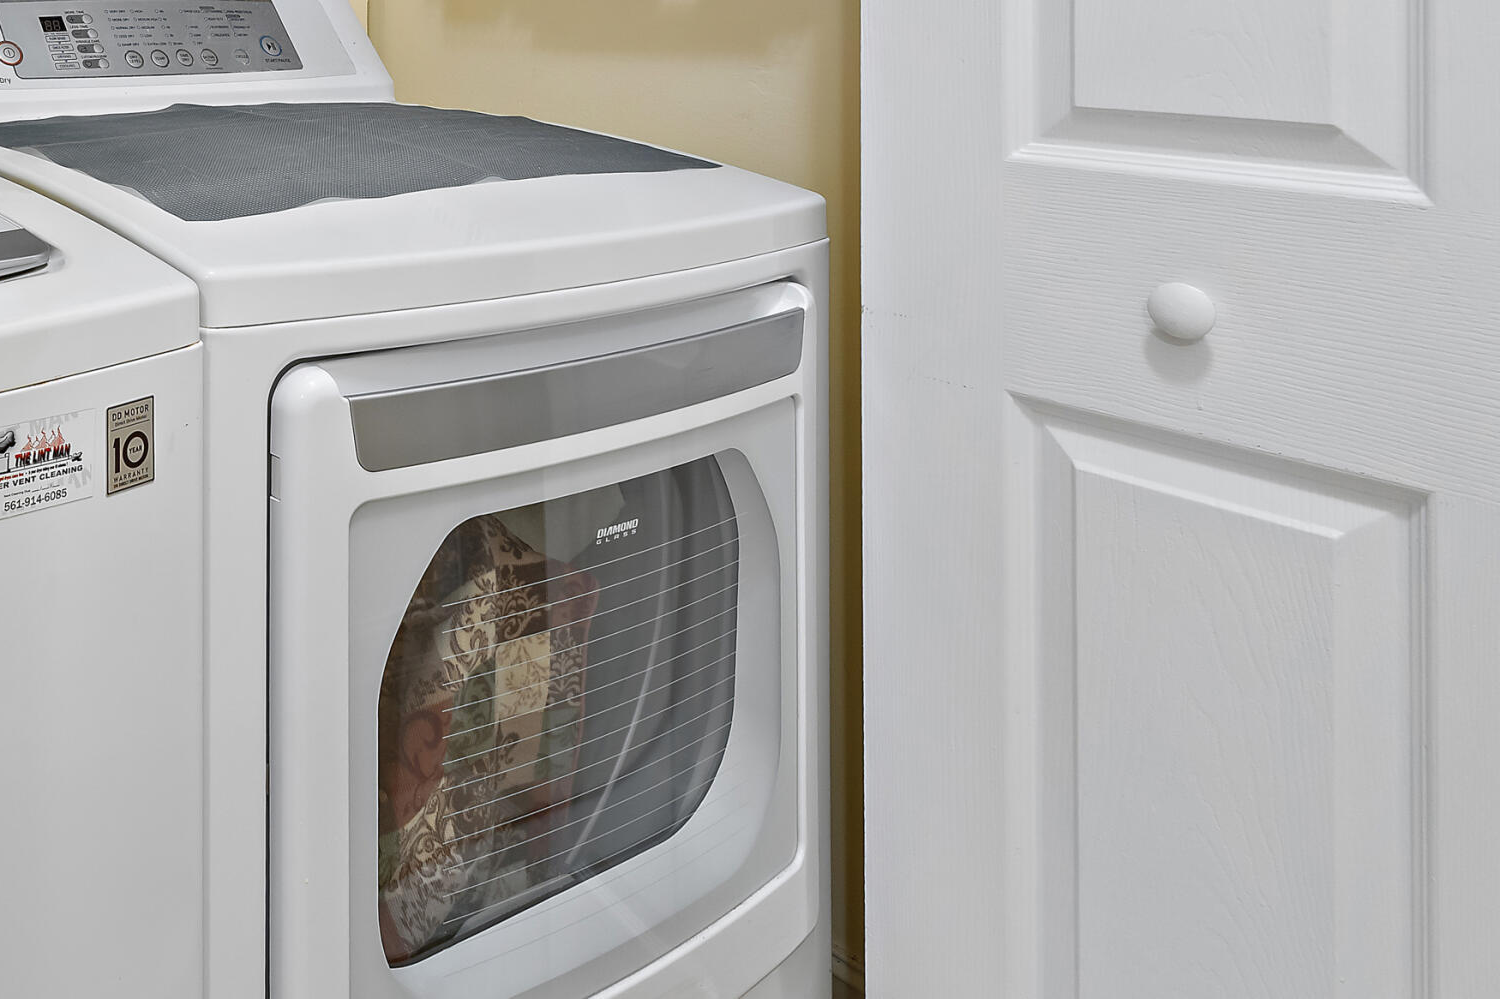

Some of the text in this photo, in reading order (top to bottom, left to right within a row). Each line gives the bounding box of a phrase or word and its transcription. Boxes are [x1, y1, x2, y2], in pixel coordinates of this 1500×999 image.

[0, 77, 11, 85] Dry
[112, 404, 149, 422] DD MOTOR
[15, 443, 71, 469] THE LINT MAN
[113, 430, 149, 474] 10
[128, 445, 142, 455] YEAR
[12, 475, 37, 488] VENT
[39, 465, 83, 481] CLEANING
[113, 467, 149, 483] WARRANTY
[3, 488, 68, 512] 561-914-6085
[596, 518, 639, 539] DIAMOND
[596, 528, 637, 545] GLASS
